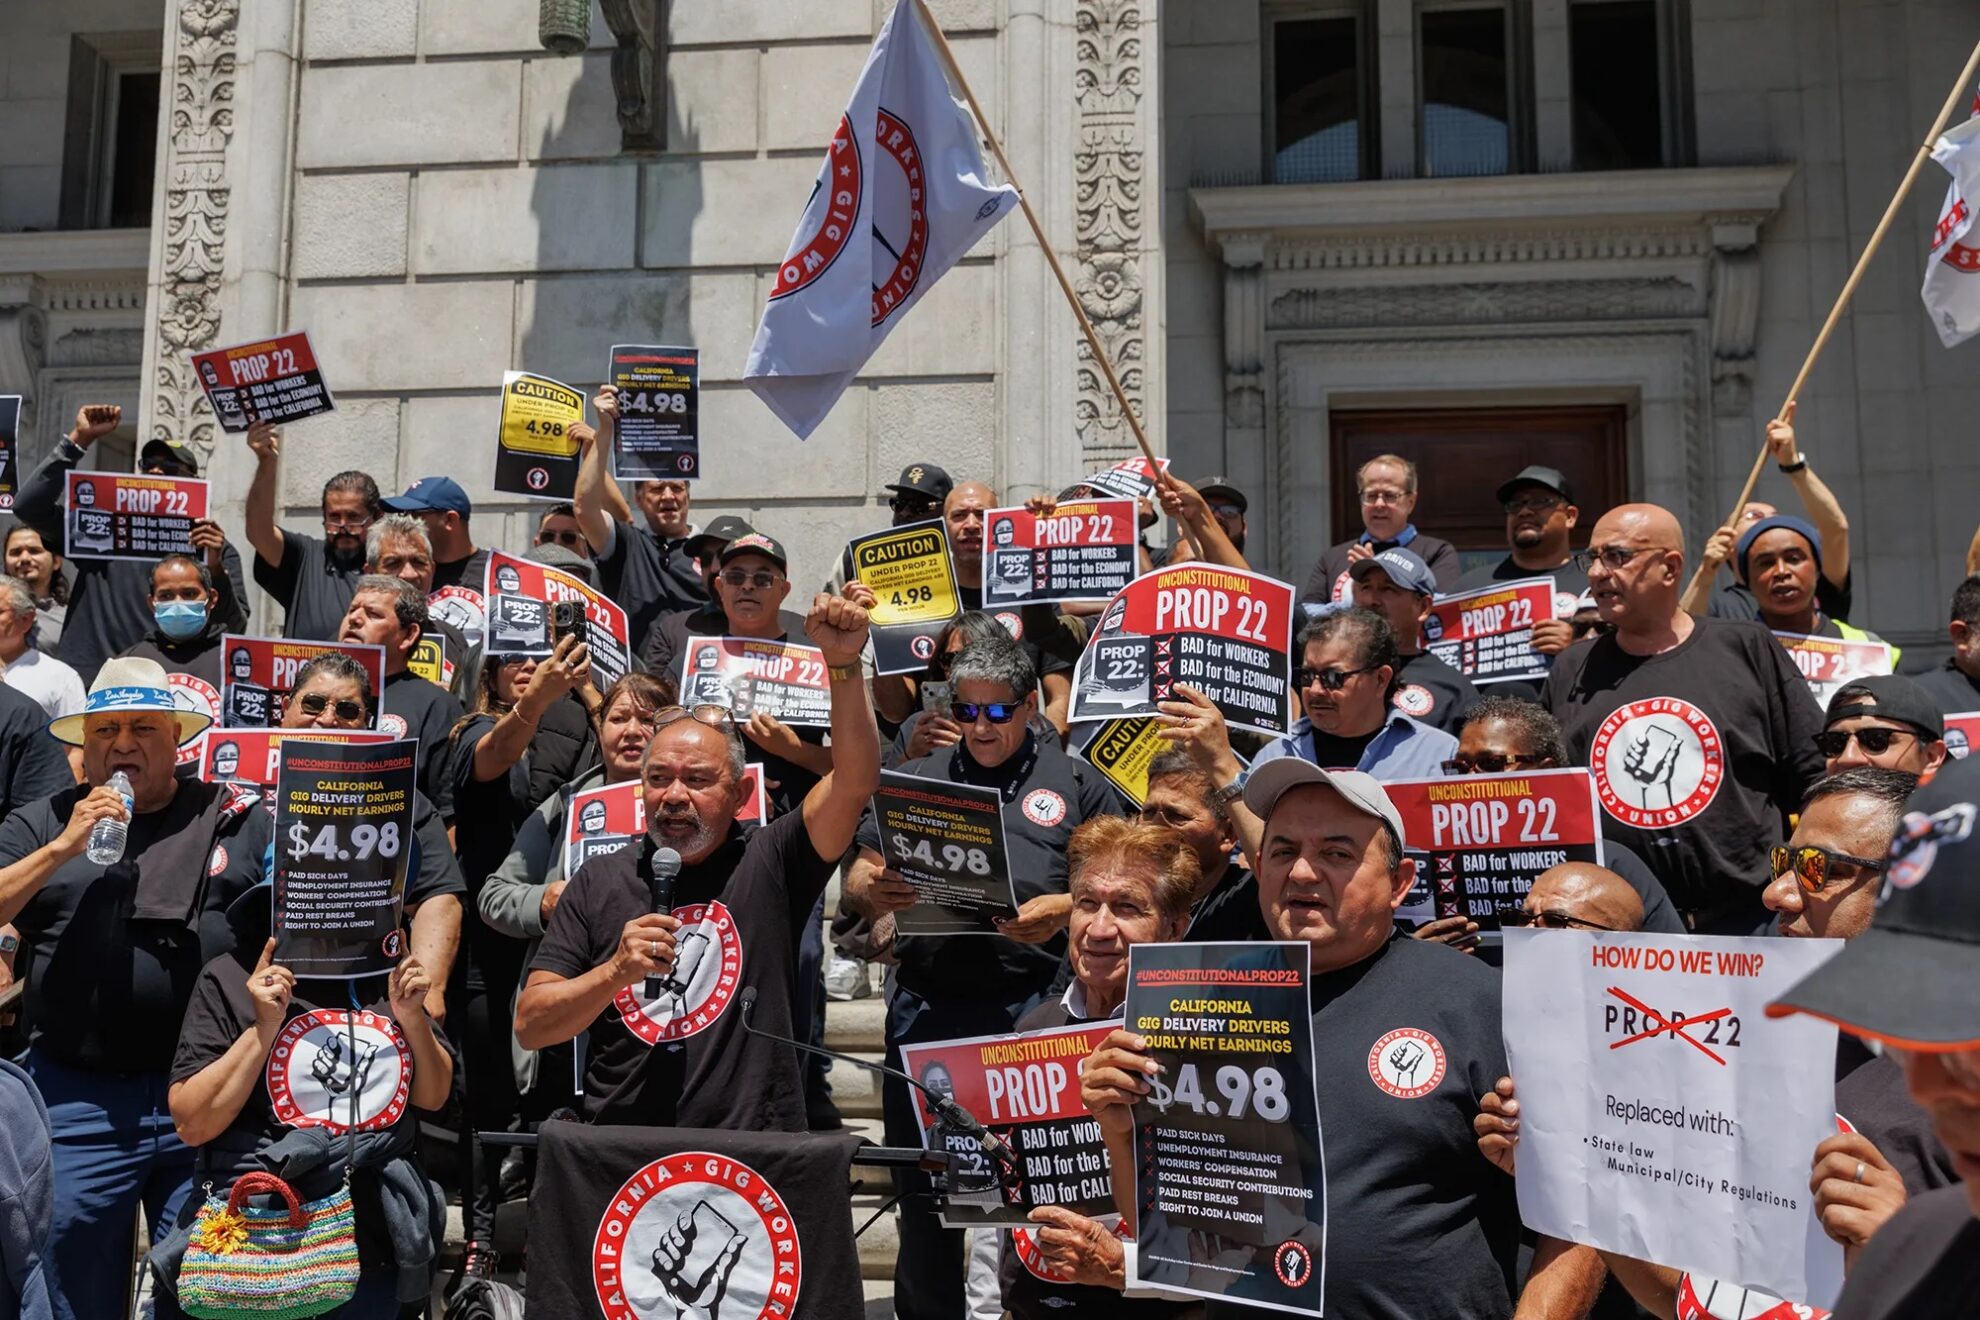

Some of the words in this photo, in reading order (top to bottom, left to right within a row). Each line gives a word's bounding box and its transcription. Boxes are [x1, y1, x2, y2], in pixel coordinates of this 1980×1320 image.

[230, 354, 269, 384] PROP
[272, 348, 298, 375] 22
[517, 382, 574, 406] CAUTION
[618, 390, 687, 413] $4.98
[526, 420, 562, 436] 4.98
[116, 488, 160, 512] PROP
[166, 492, 188, 515] 22
[86, 524, 110, 535] 22:
[1035, 516, 1083, 545] PROP
[1088, 515, 1113, 542] 22
[865, 537, 934, 563] CAUTION
[1000, 555, 1029, 564] PROP
[1052, 550, 1066, 561] BAD
[1068, 549, 1079, 560] for
[1081, 548, 1117, 559] WORKERS
[870, 566, 900, 577] UNDER
[902, 561, 926, 572] PROP
[1004, 565, 1029, 577] 22:
[1052, 564, 1066, 575] BAD
[1068, 564, 1080, 574] for
[1081, 563, 1094, 573] the
[1096, 561, 1130, 573] ECONOMY
[1052, 578, 1066, 589] BAD
[1068, 578, 1080, 588] for
[1081, 576, 1125, 588] CALIFORNIA
[1158, 570, 1251, 594] UNCONSTITUTIONAL
[505, 601, 540, 611] PROP
[891, 586, 932, 606] 4.98
[511, 611, 540, 624] 22:
[592, 602, 612, 632] 22
[1156, 588, 1229, 630] PROP
[1236, 596, 1267, 642] 22
[1461, 604, 1506, 637] PROP
[1509, 598, 1532, 627] 22
[1101, 646, 1146, 659] PROP
[1181, 637, 1204, 654] BAD
[1206, 640, 1222, 657] for
[1225, 642, 1269, 669] WORKERS
[797, 661, 824, 686] 22
[1108, 660, 1144, 679] 22:
[1180, 659, 1203, 676] BAD
[1206, 663, 1222, 680] for
[1224, 665, 1240, 683] the
[1243, 668, 1285, 696] ECONOMY
[236, 690, 266, 703] PROP
[1205, 684, 1221, 701] for
[1223, 687, 1277, 716] CALIFORNIA
[1651, 700, 1681, 712] GIG
[240, 702, 265, 718] 22:
[1142, 723, 1160, 744] PROP
[1120, 744, 1143, 770] UNDER
[1595, 707, 1634, 806] CALIFORNIA
[1688, 709, 1719, 795] WORKERS
[287, 758, 411, 770] #UNCONSTITUTIONALPROP22
[291, 791, 309, 801] GIG
[311, 793, 364, 803] DELIVERY
[367, 790, 404, 803] DRIVERS
[317, 781, 383, 791] CALIFORNIA
[1429, 780, 1532, 800] UNCONSTITUTIONAL
[289, 804, 330, 816] HOURLY
[333, 806, 354, 816] NET
[357, 802, 404, 815] EARNINGS
[909, 806, 966, 822] CALIFORNIA
[1629, 805, 1691, 824] UNION
[887, 811, 904, 820] GIG
[906, 814, 949, 828] DELIVERY
[951, 822, 991, 835] DRIVERS
[888, 820, 924, 832] HOURLY
[926, 827, 942, 836] NET
[944, 831, 992, 844] EARNINGS
[1432, 800, 1509, 847] PROP
[1518, 798, 1559, 842] 22
[287, 820, 400, 862] $4.98
[892, 833, 991, 875] $4.98
[1463, 855, 1487, 872] BAD
[1489, 854, 1506, 871] for
[1509, 851, 1566, 869] WORKERS
[327, 890, 387, 899] COMPENSATION
[350, 879, 391, 888] INSURANCE
[1465, 877, 1489, 894] BAD
[1492, 876, 1509, 893] for
[1512, 875, 1531, 892] the
[1468, 900, 1492, 916] BAD
[350, 920, 374, 928] UNION
[718, 919, 737, 1000] ORKERS
[1592, 946, 1641, 969] HOW
[1644, 948, 1674, 971] DO
[1680, 951, 1712, 974] WE
[1718, 952, 1763, 977] WIN?
[1136, 969, 1298, 982] #UNCONSTITUTIONALPROP22
[1170, 999, 1252, 1014] CALIFORNIA
[1137, 1017, 1160, 1029] GIG
[1163, 1018, 1226, 1032] DELIVERY
[1229, 1020, 1290, 1034] DRIVERS
[1412, 1031, 1430, 1040] GIG
[1606, 1005, 1686, 1039] PROP
[1703, 1016, 1741, 1047] 22
[980, 1035, 1092, 1066] UNCONSTITUTIONAL
[1190, 1037, 1215, 1050] NET
[1219, 1038, 1292, 1054] EARNINGS
[1370, 1032, 1401, 1081] CALIFORNIA
[272, 1015, 320, 1119] CALIFORNIA
[985, 1062, 1067, 1119] PROP
[1142, 1063, 1290, 1123] $4.98
[1388, 1087, 1422, 1096] UNION
[1607, 1095, 1684, 1128] Replaced
[1690, 1110, 1734, 1136] with:
[1022, 1128, 1047, 1150] BAD
[1050, 1126, 1069, 1148] for
[1157, 1128, 1177, 1138] PAID
[1179, 1130, 1200, 1140] SICK
[1202, 1133, 1225, 1143] DAYS
[1158, 1143, 1227, 1159] UNEMPLOYMENT
[1229, 1151, 1282, 1164] INSURANCE
[1592, 1136, 1624, 1153] State
[1630, 1142, 1654, 1159] law
[704, 1159, 750, 1188] GIG
[1026, 1158, 1051, 1177] BAD
[1054, 1155, 1073, 1174] for
[1076, 1152, 1100, 1172] the
[1158, 1157, 1202, 1171] WORKERS'
[1204, 1162, 1277, 1179] COMPENSATION
[1030, 1184, 1054, 1204] BAD
[1058, 1182, 1078, 1202] for
[1159, 1172, 1191, 1184] SOCIAL
[1193, 1176, 1235, 1189] SECURITY
[1237, 1182, 1313, 1199] CONTRIBUTIONS
[1608, 1157, 1714, 1194] Municipal/City
[1722, 1180, 1797, 1209] Regulations
[1159, 1187, 1180, 1197] PAID
[1182, 1190, 1202, 1200] REST
[1204, 1193, 1238, 1205] BREAKS
[1159, 1202, 1186, 1213] RIGHT
[1187, 1205, 1199, 1215] TO
[1200, 1207, 1223, 1218] JOIN
[1225, 1210, 1232, 1220] A
[1233, 1212, 1263, 1224] UNION
